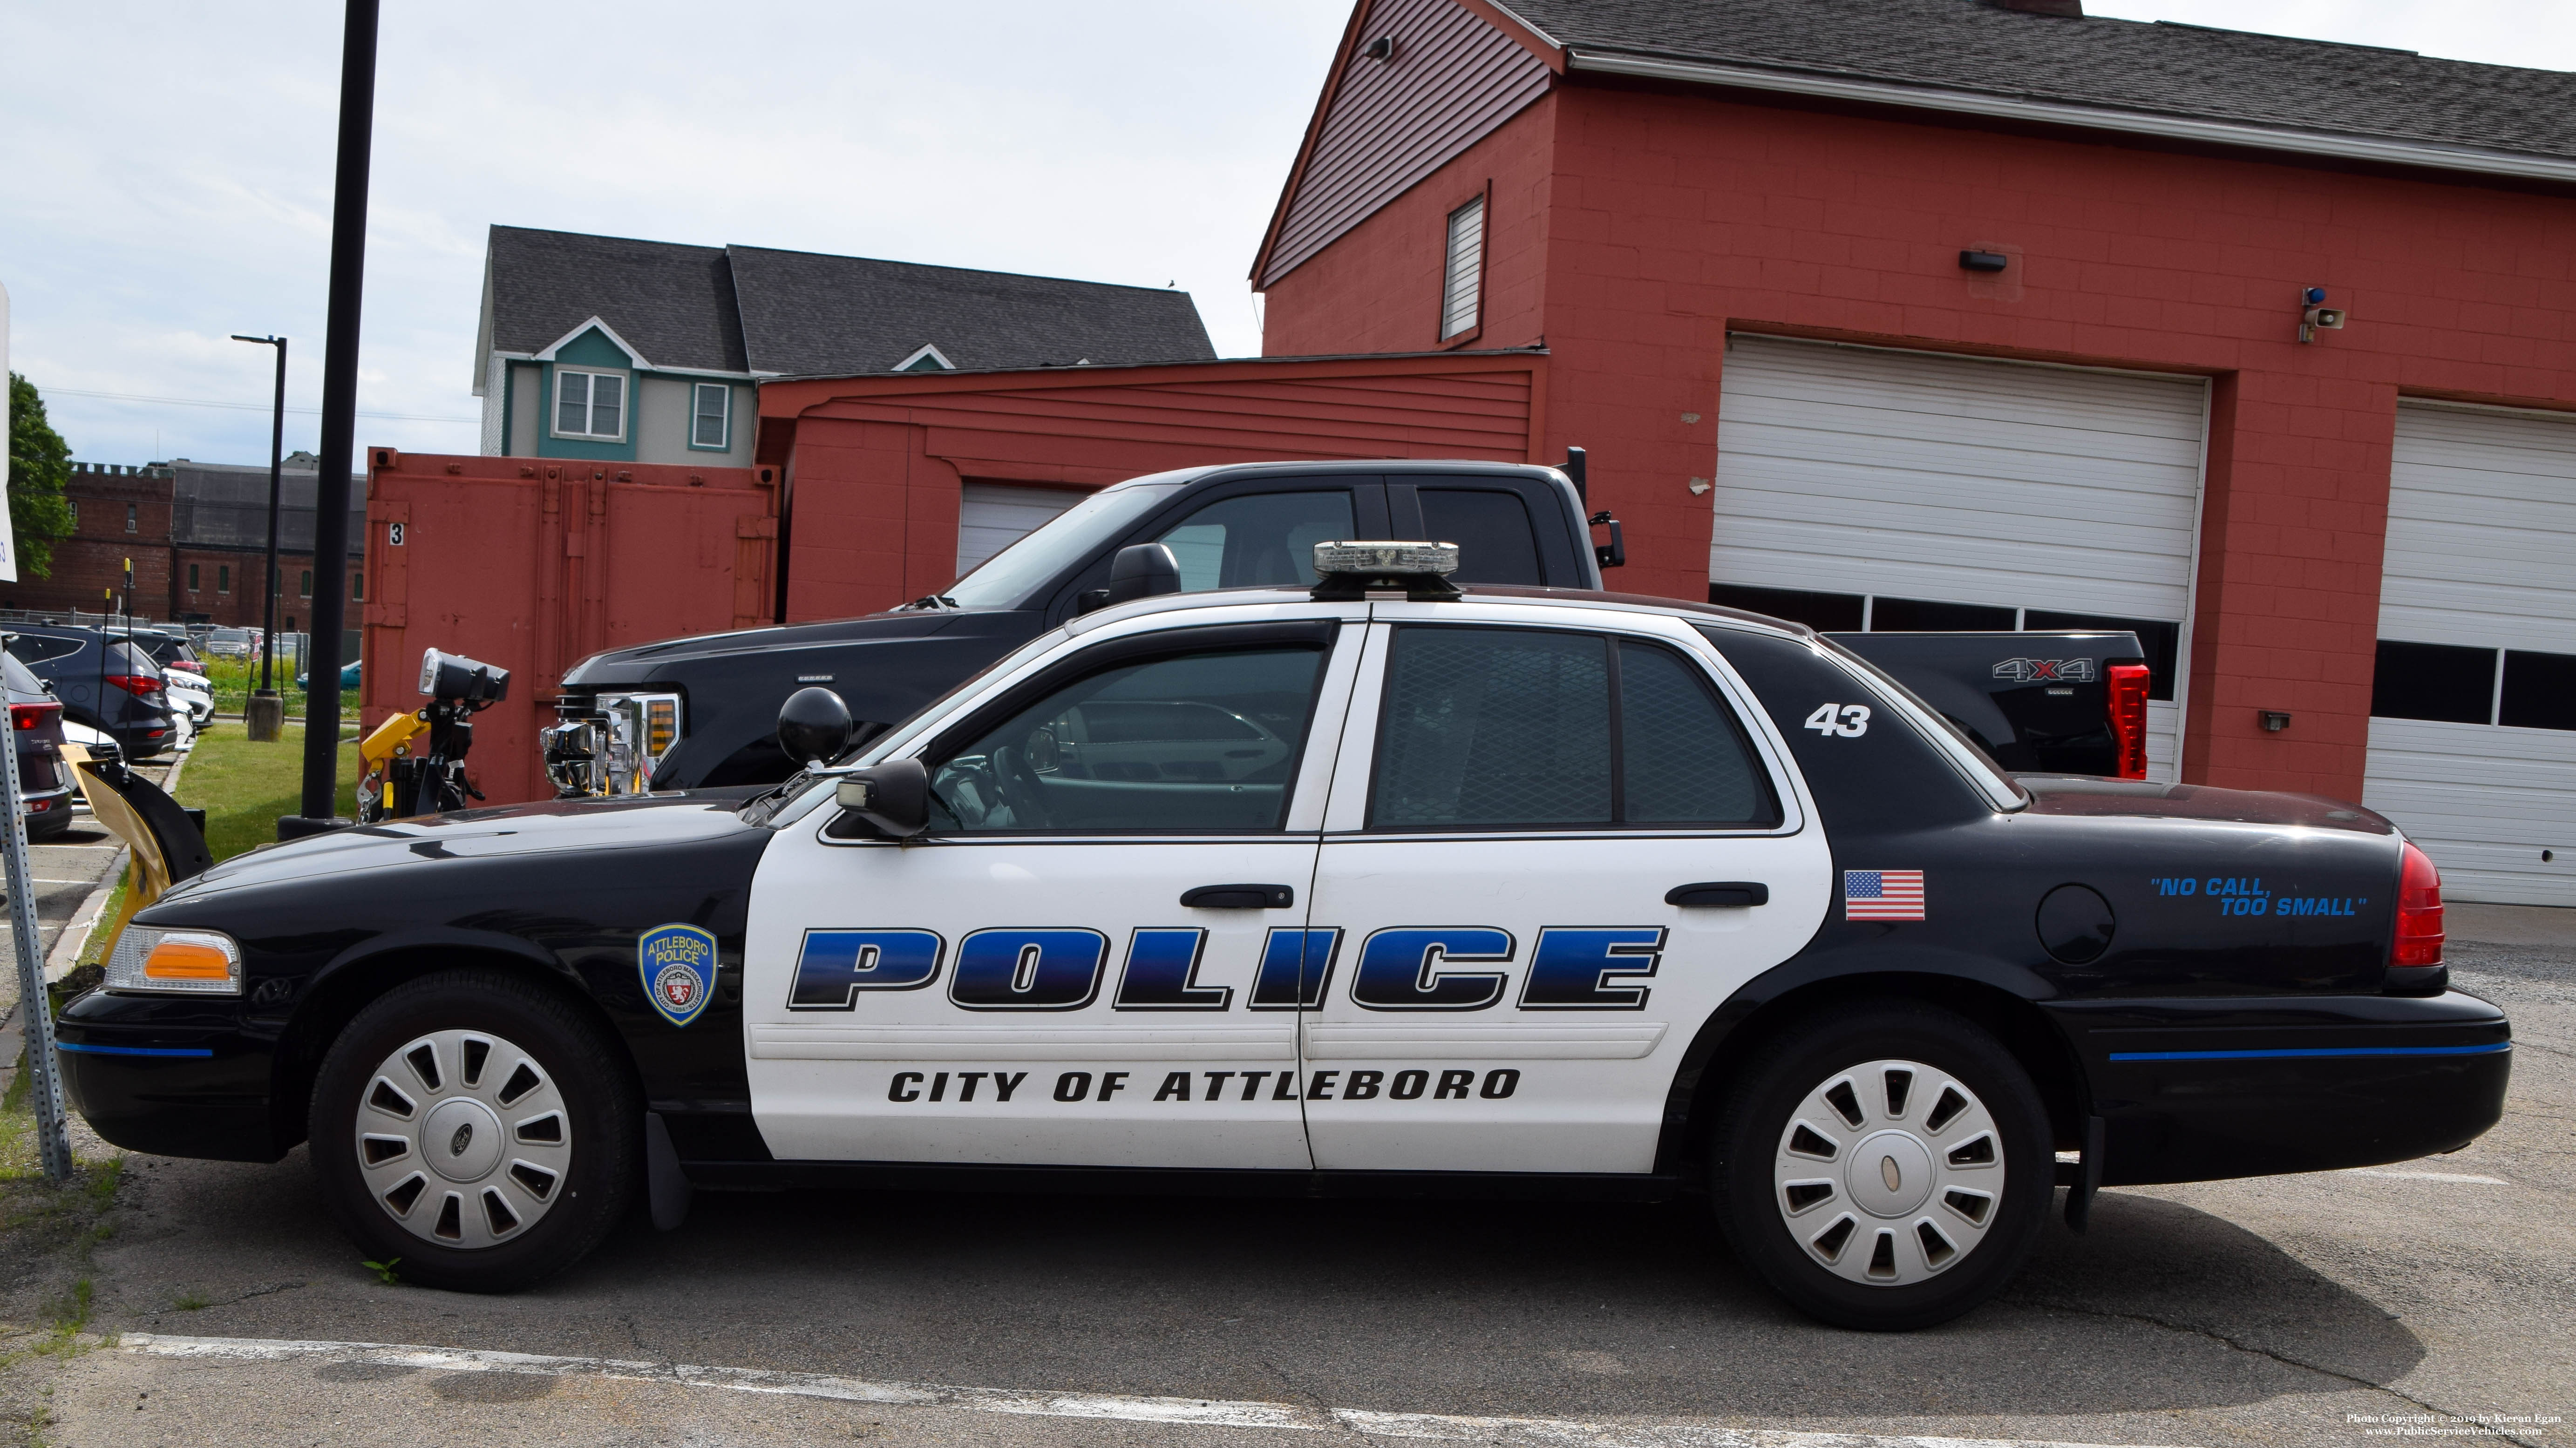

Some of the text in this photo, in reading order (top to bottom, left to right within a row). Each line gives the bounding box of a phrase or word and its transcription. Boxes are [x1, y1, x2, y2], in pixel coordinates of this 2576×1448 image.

[391, 524, 402, 544] 3
[1805, 703, 1871, 738] 43
[2151, 878, 2271, 899] "NO CALL,
[2221, 898, 2367, 916] TOO SMALL"
[648, 936, 708, 956] ATTLEBORO
[656, 949, 700, 966] POLICE
[656, 965, 682, 987] ATTLEBORO
[785, 925, 1670, 1012] POLICE
[683, 967, 702, 1009] MASSACHUSETTS
[659, 997, 669, 1008] CITY
[888, 1069, 1522, 1103] CITY OF ATTLEBORO
[455, 1131, 468, 1150] Ford
